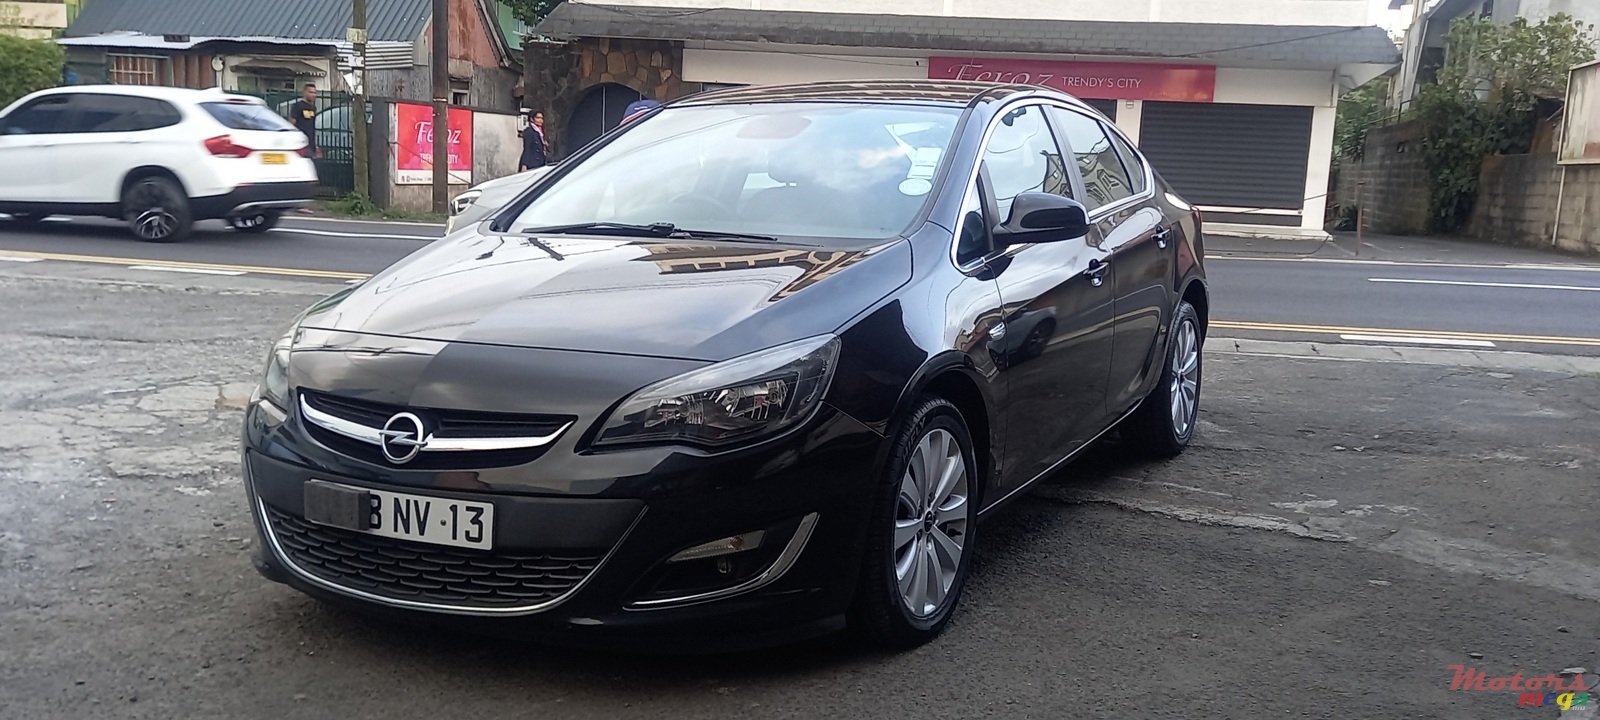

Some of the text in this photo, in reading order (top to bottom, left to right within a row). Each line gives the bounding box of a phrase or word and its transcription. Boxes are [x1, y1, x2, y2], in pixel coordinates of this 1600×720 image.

[1062, 76, 1113, 88] TRENDY'S
[1116, 78, 1142, 88] CITY
[393, 496, 431, 537] NV
[449, 504, 484, 543] 13
